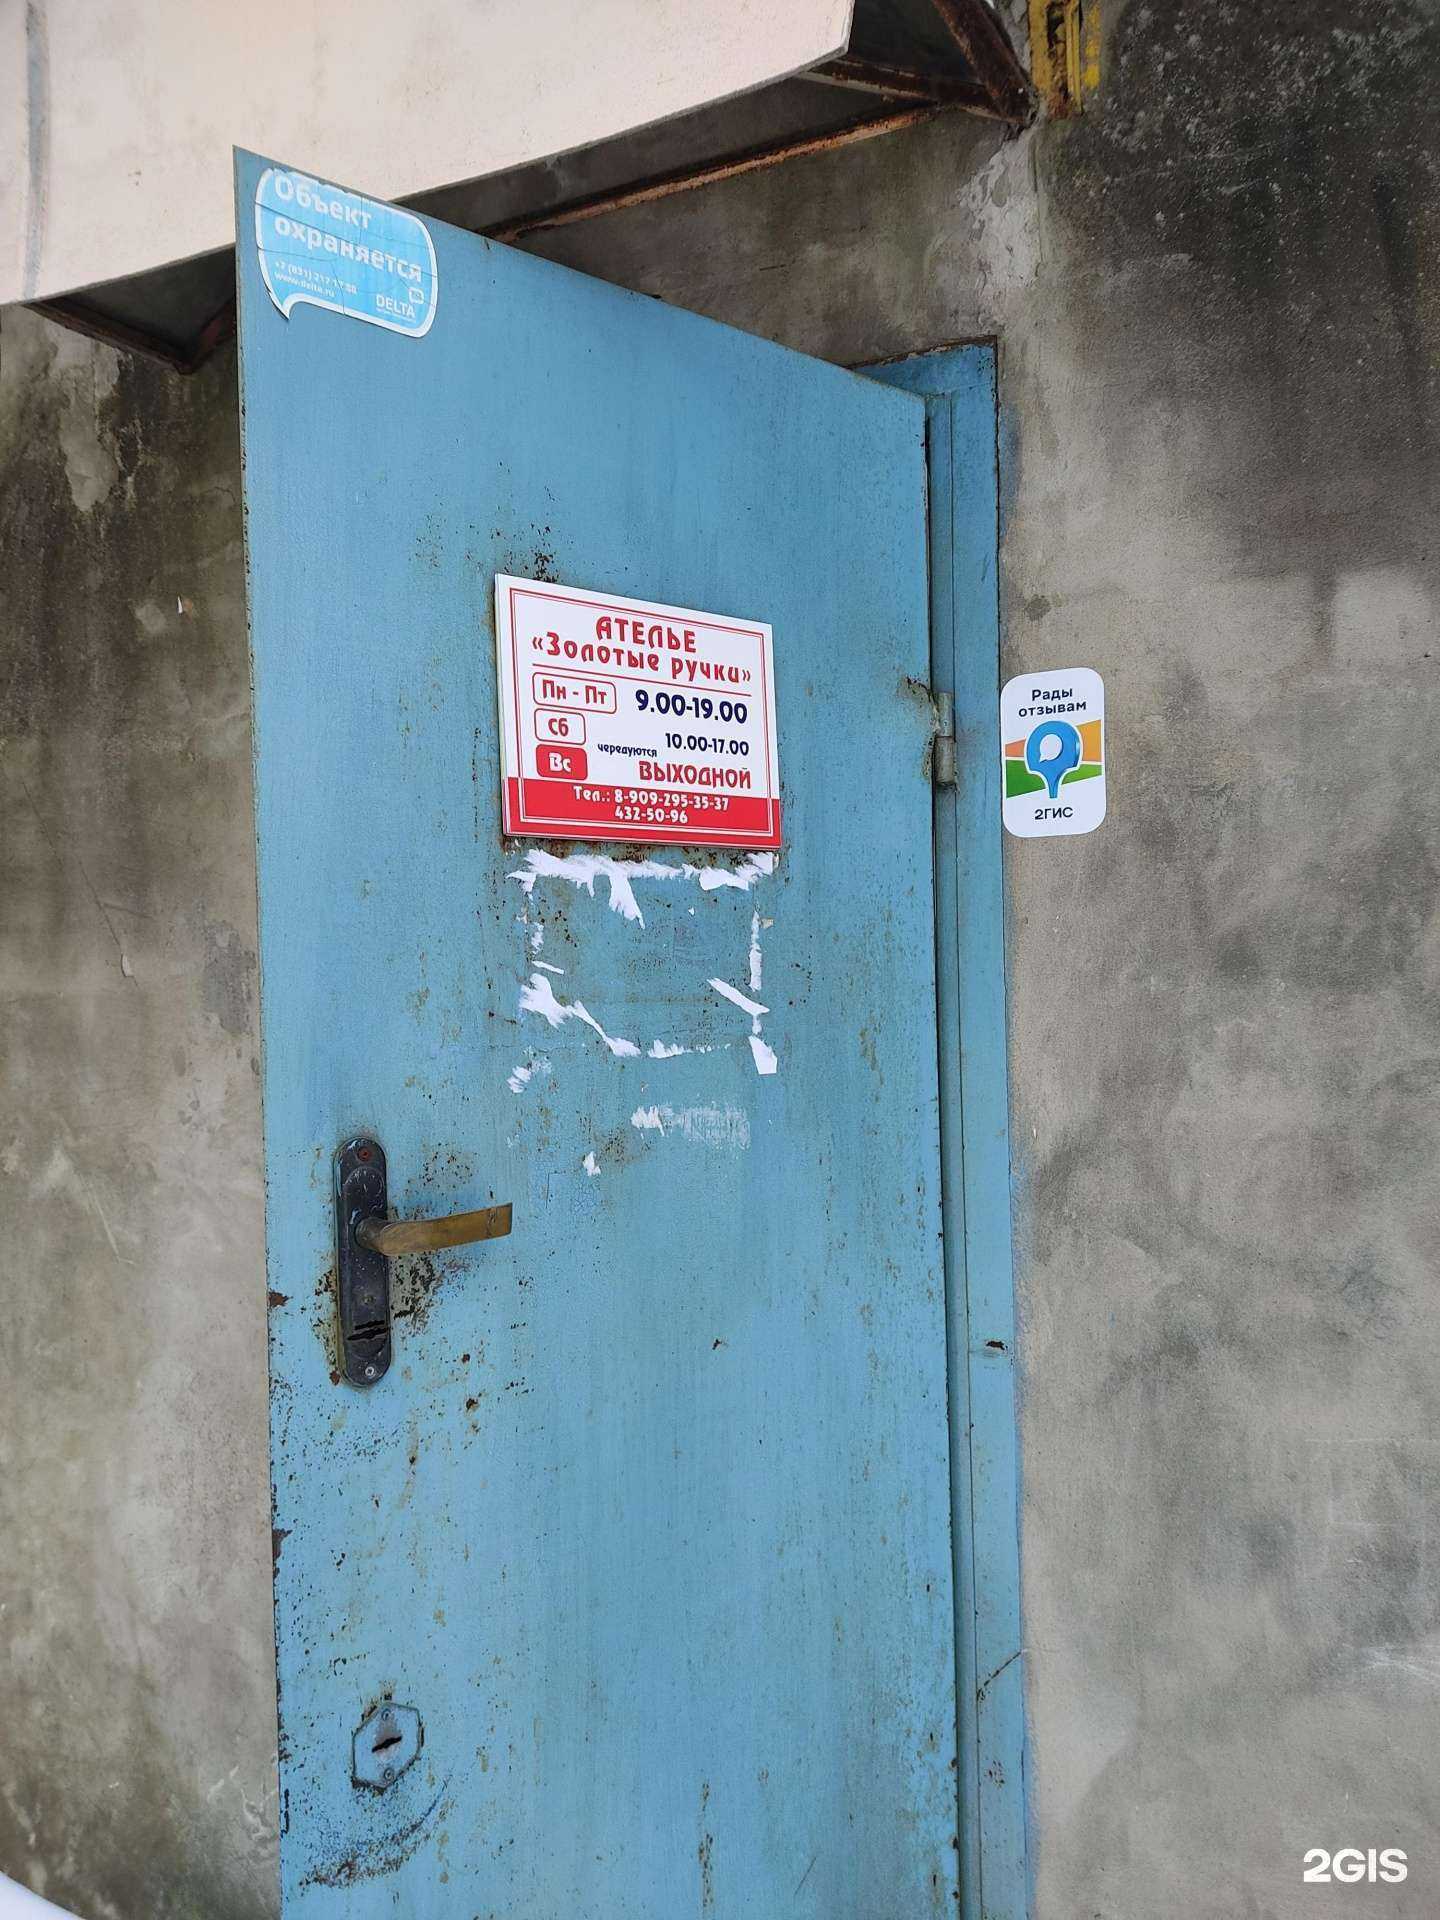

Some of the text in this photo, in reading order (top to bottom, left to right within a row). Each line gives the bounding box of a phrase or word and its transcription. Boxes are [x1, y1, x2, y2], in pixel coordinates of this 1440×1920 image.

[274, 174, 373, 229] Объект
[274, 216, 422, 283] охраняется
[376, 293, 416, 319] DELTA
[595, 615, 697, 653] АТЕЛЬЕ
[532, 632, 751, 684] «Золотые ручки»
[542, 679, 567, 700] Пн
[585, 685, 608, 705] Пт
[635, 689, 748, 724] 9.00-19.00
[1018, 701, 1087, 718] отзывам
[1031, 687, 1073, 702] Рады
[548, 717, 750, 757] Сб 10.00-17.00
[597, 743, 658, 758] чередуются
[549, 752, 751, 790] Вс ВЫХОДНОЙ
[573, 785, 729, 811] Тел.: 8-909-295-35-37
[1034, 806, 1073, 821] 2ГИС
[614, 806, 688, 824] 432-50-96
